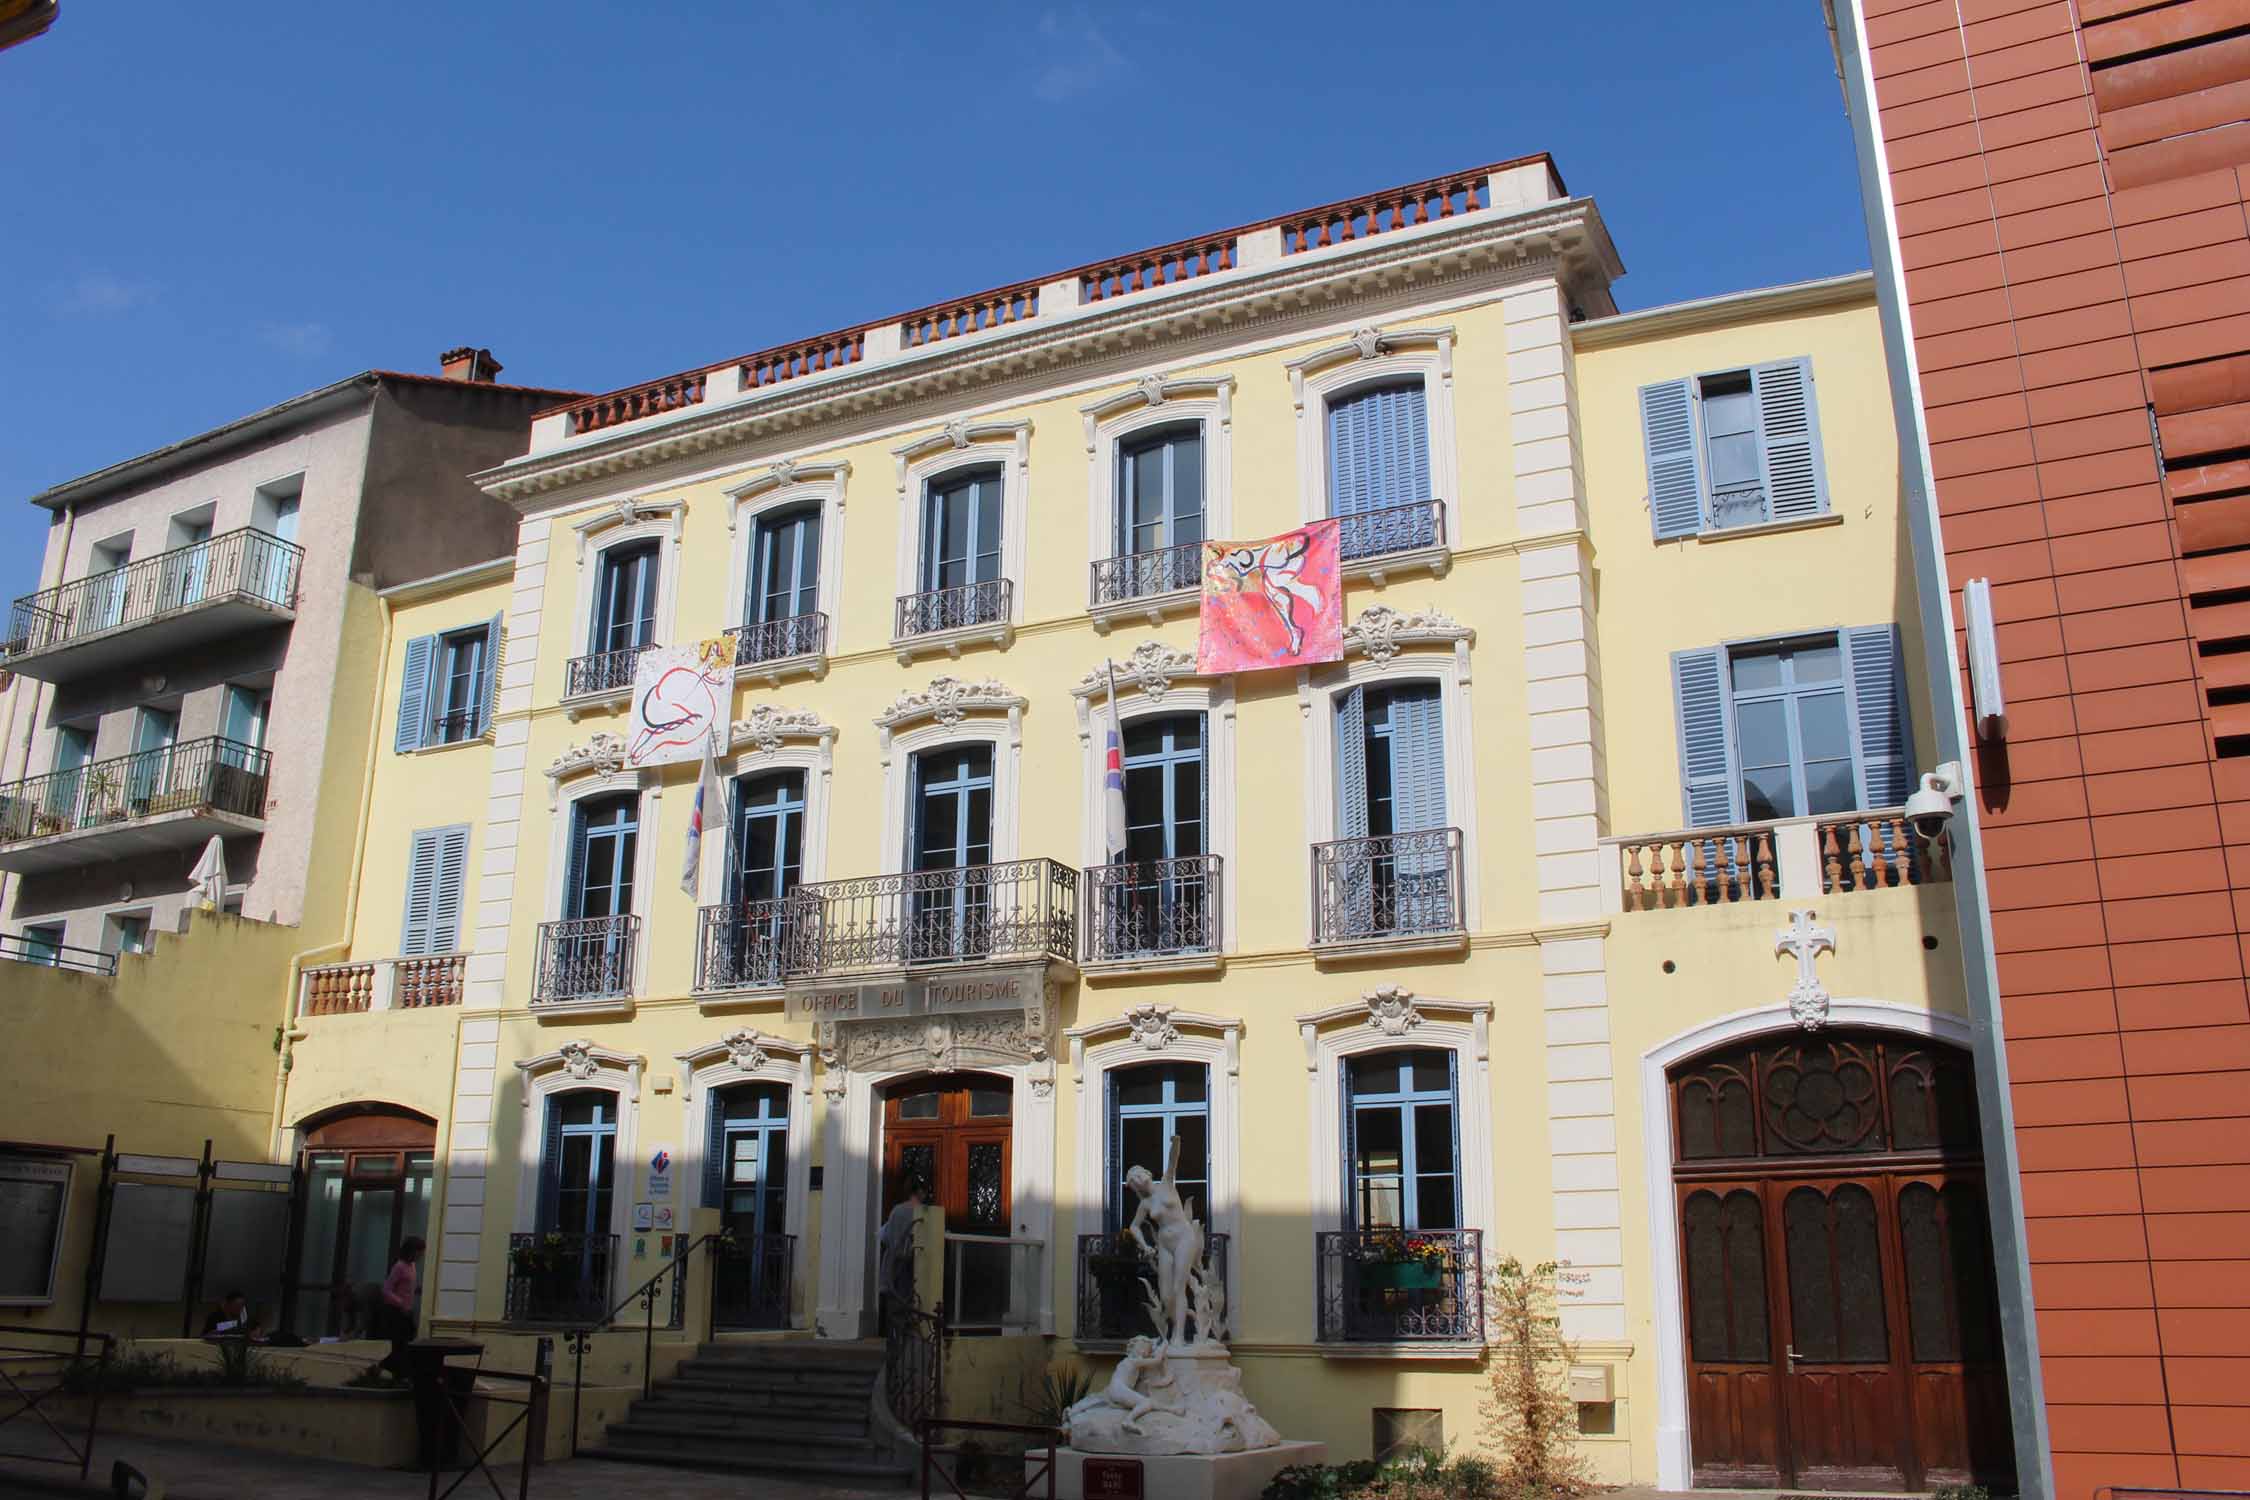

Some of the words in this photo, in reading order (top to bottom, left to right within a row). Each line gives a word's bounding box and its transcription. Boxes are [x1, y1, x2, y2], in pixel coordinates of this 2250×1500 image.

[802, 992, 857, 1012] OFFICE
[880, 989, 904, 1008] DU
[931, 979, 1020, 1003] TOURISME
